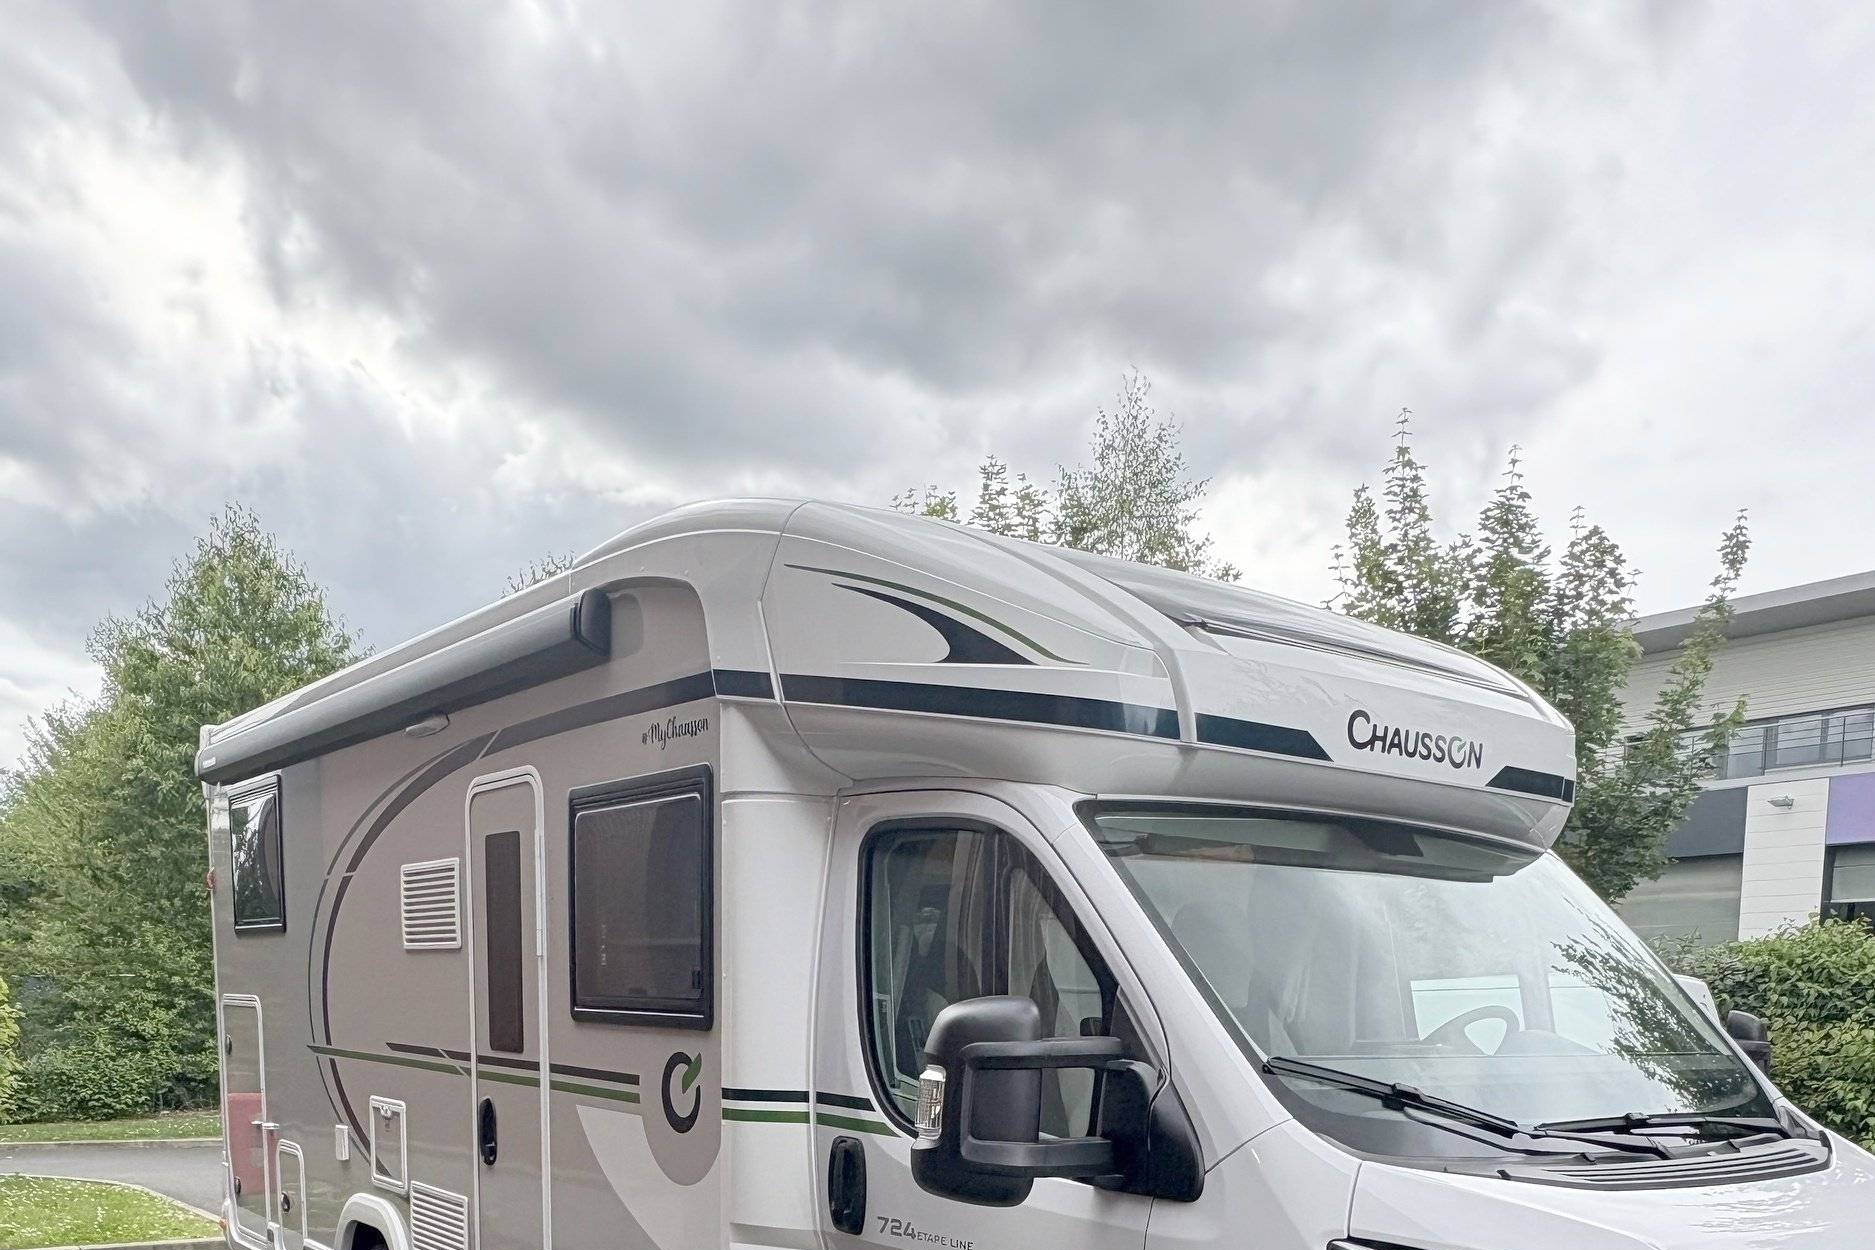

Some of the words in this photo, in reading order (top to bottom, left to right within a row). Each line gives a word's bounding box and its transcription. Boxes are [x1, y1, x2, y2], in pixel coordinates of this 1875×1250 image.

[877, 1216, 916, 1240] 724
[917, 1231, 947, 1246] ETAPE
[950, 1239, 974, 1250] LINE
